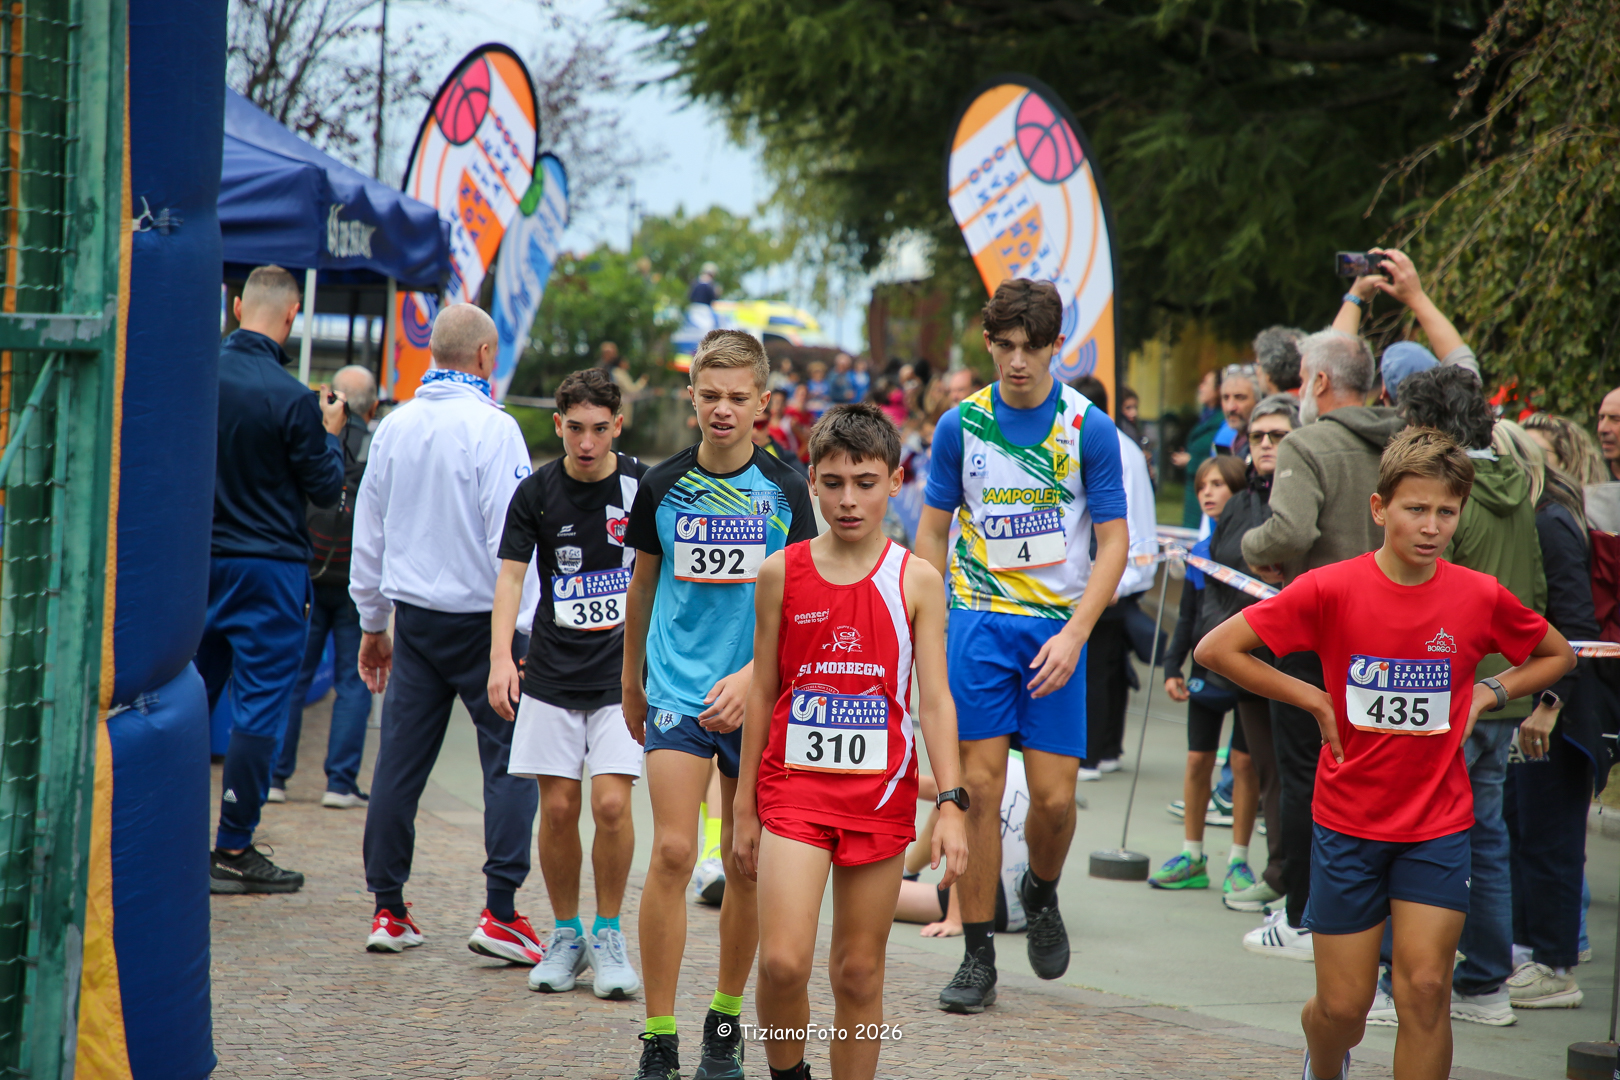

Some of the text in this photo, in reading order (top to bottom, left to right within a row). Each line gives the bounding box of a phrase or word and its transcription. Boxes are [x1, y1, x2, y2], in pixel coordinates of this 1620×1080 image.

[1014, 511, 1058, 523] CENTRO
[1015, 517, 1059, 529] SPORTIVO
[1015, 522, 1060, 534] ITALIANO
[1017, 541, 1032, 562] 4
[690, 547, 745, 575] 392
[586, 571, 630, 582] CENTRO
[586, 577, 631, 589] SPORTIVO
[572, 598, 620, 625] 388
[794, 608, 830, 622] panzeri
[1427, 645, 1451, 653] BORGO
[814, 661, 886, 678] MORBEGN
[1394, 664, 1449, 672] CENTRO
[1393, 671, 1449, 680] SPORTIVO
[1393, 679, 1449, 687] ITALIANO
[831, 700, 886, 708] CENTRO
[831, 707, 886, 716] SPORTIVO
[1366, 695, 1430, 727] 435
[831, 715, 886, 724] ITALIANO
[806, 731, 866, 765] 310
